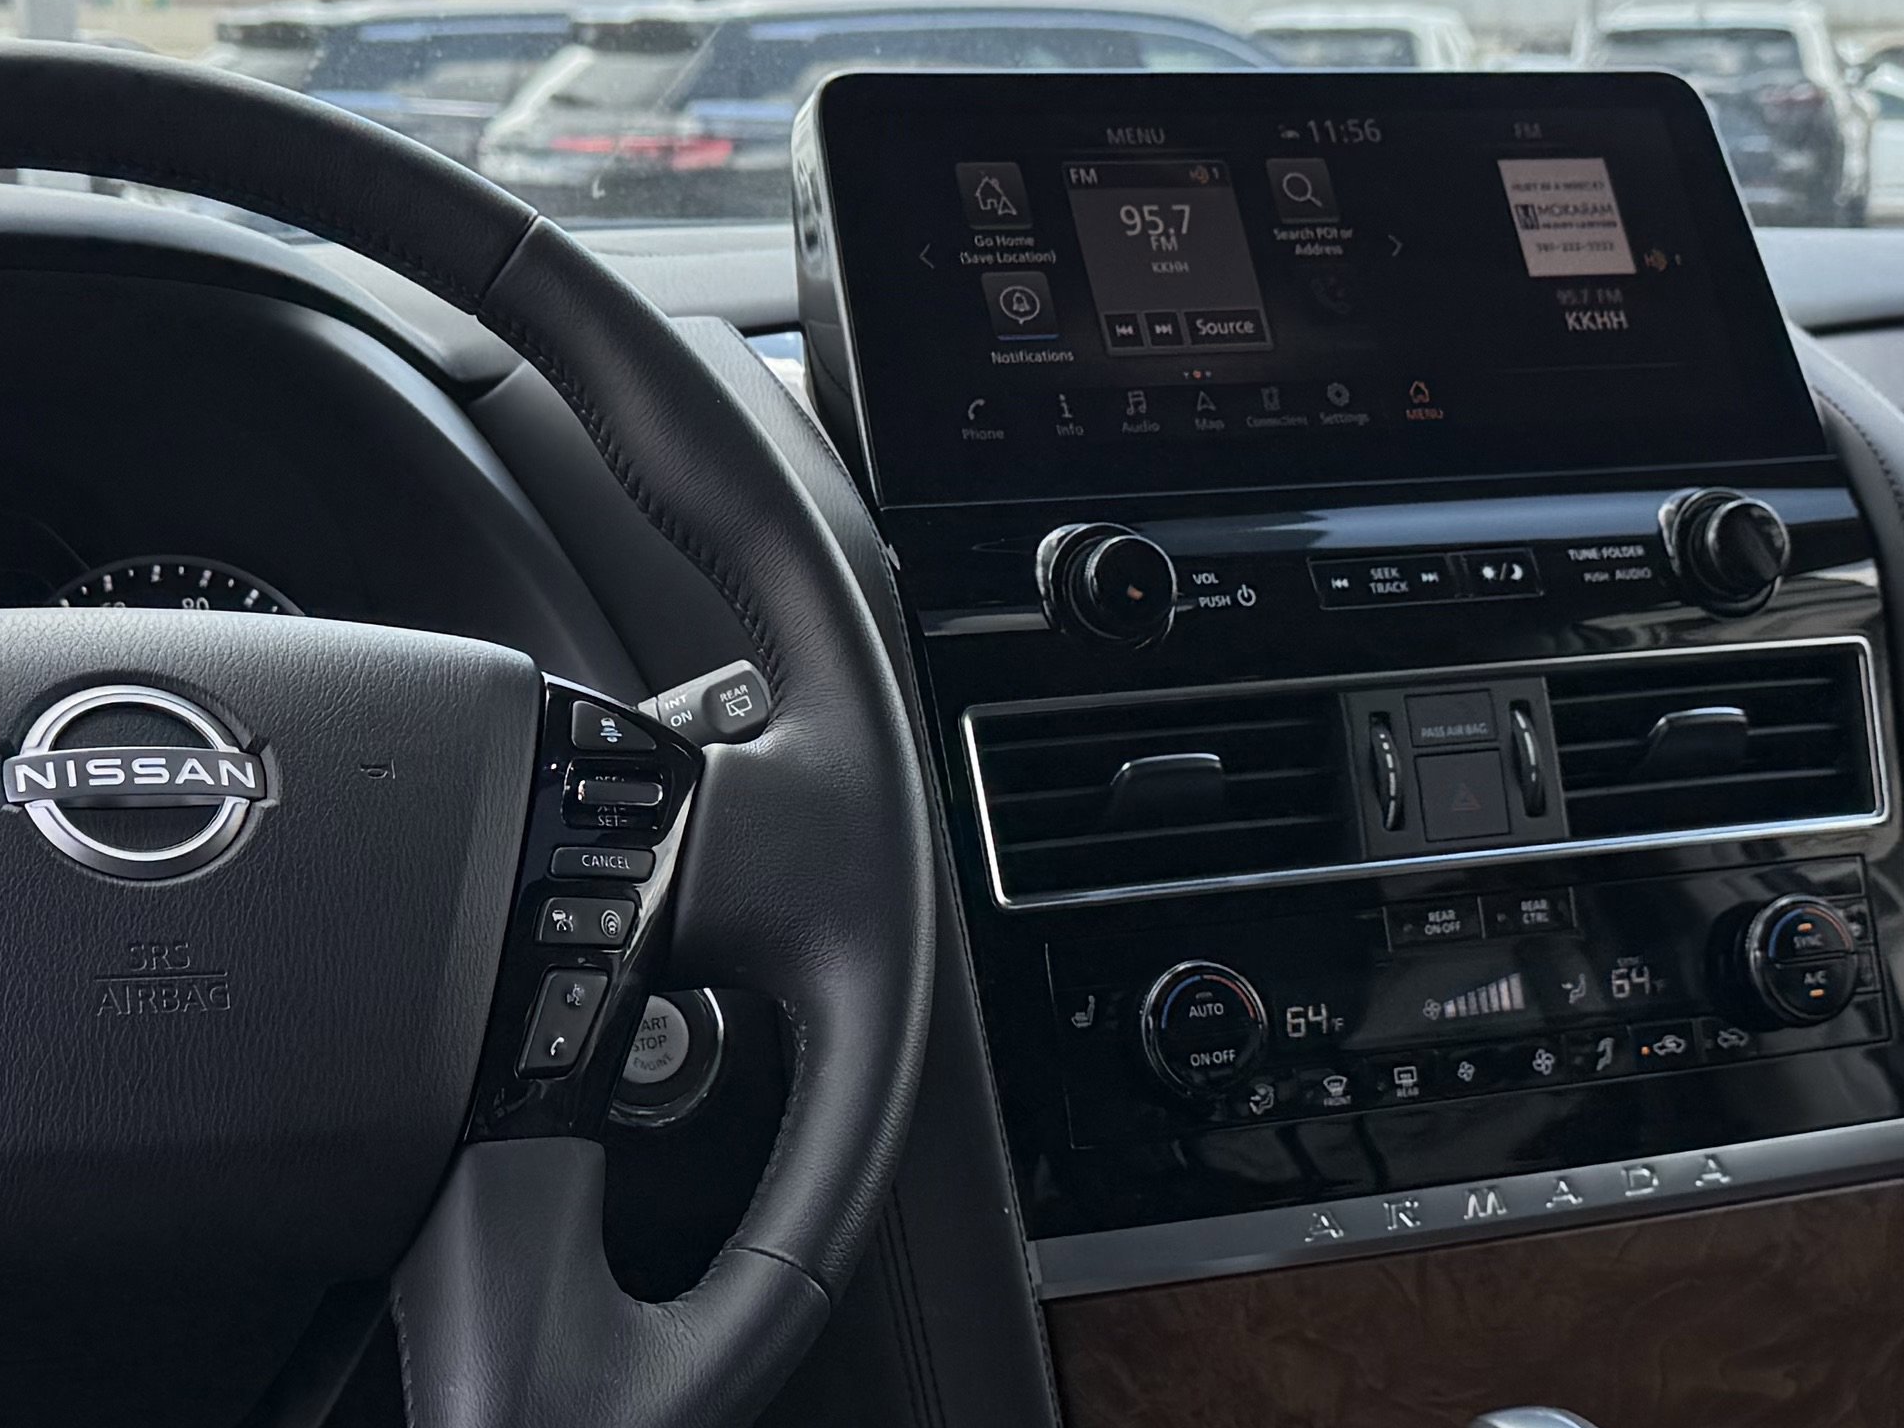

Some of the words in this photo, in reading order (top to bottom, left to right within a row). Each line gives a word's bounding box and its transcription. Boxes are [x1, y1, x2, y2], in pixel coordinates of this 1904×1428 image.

[1107, 127, 1165, 145] MENU
[1309, 119, 1382, 144] 11:56
[1069, 168, 1097, 185] FM
[1119, 204, 1192, 235] 95.7
[974, 235, 993, 248] Go
[995, 235, 1035, 247] Home
[1149, 235, 1179, 252] FM
[960, 252, 995, 266] (Save
[997, 250, 1057, 265] Location)
[1195, 319, 1256, 335] Source
[1564, 310, 1629, 331] KKHH
[991, 351, 1075, 365] Notifications
[961, 428, 1005, 441] Phone
[1056, 423, 1085, 437] Info
[1122, 420, 1161, 434] Audio
[1192, 572, 1219, 585] VOL
[1369, 567, 1400, 580] SEEK
[1368, 580, 1409, 594] TRACK
[1198, 595, 1231, 609] PUSH
[719, 685, 749, 702] REAR
[664, 694, 687, 712] INT
[670, 710, 693, 728] ON
[14, 757, 256, 793] NISSAN
[581, 854, 631, 869] CANCEL
[1520, 898, 1550, 912] REAR
[1427, 909, 1456, 923] REAR
[127, 942, 191, 972] SRS
[1804, 970, 1828, 985] A/C
[96, 982, 232, 1017] AIRBAG
[1189, 1003, 1224, 1018] AUTO
[641, 1016, 669, 1032] ART
[633, 1053, 674, 1071] ENGINE
[1305, 1154, 1733, 1244] ARMADA
